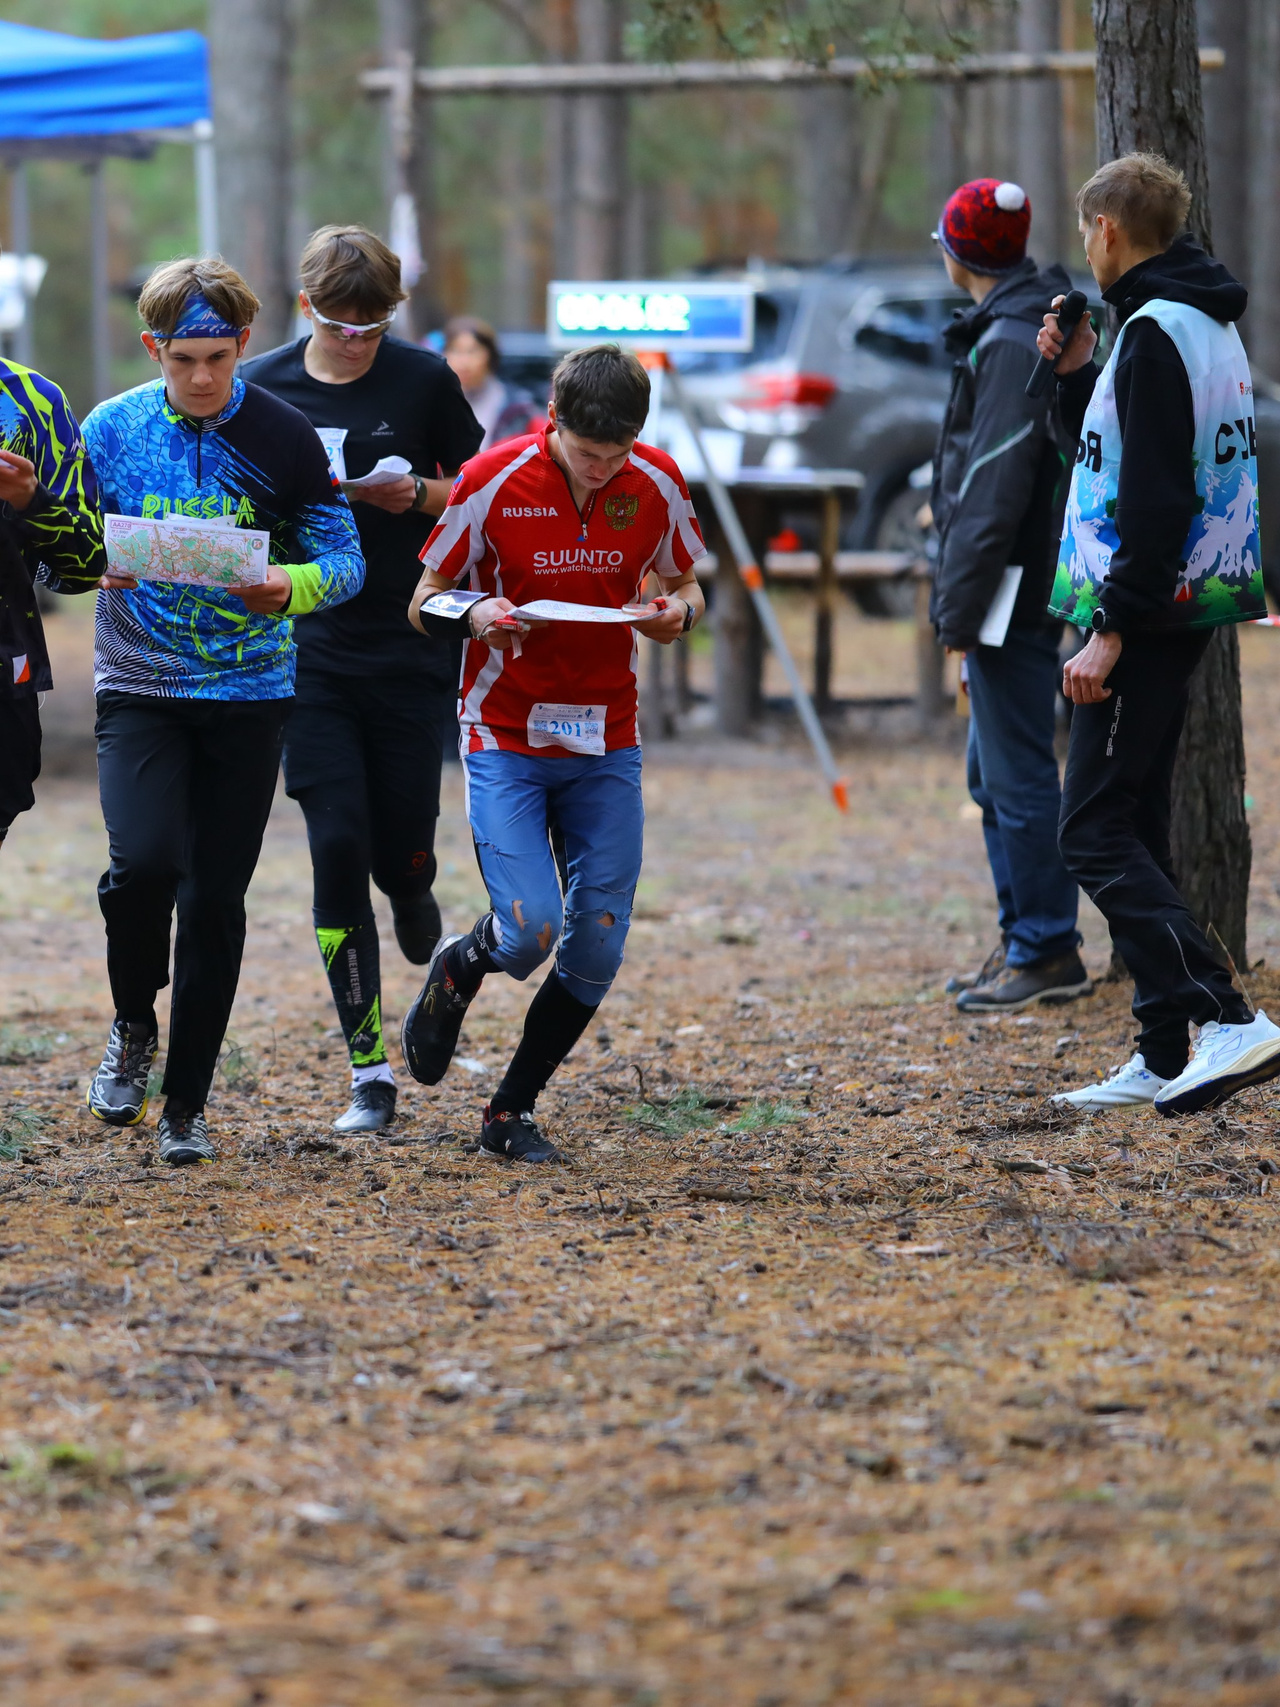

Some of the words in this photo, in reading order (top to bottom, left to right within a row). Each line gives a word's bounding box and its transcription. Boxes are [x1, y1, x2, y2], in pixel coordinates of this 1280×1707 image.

[141, 494, 255, 526] RUSSIA
[502, 506, 558, 517] RUSSIA
[533, 548, 623, 567] SUUNTO
[534, 563, 620, 575] www.watchsport.ru
[550, 721, 582, 737] 201
[347, 949, 363, 1006] ORIENTEERING
